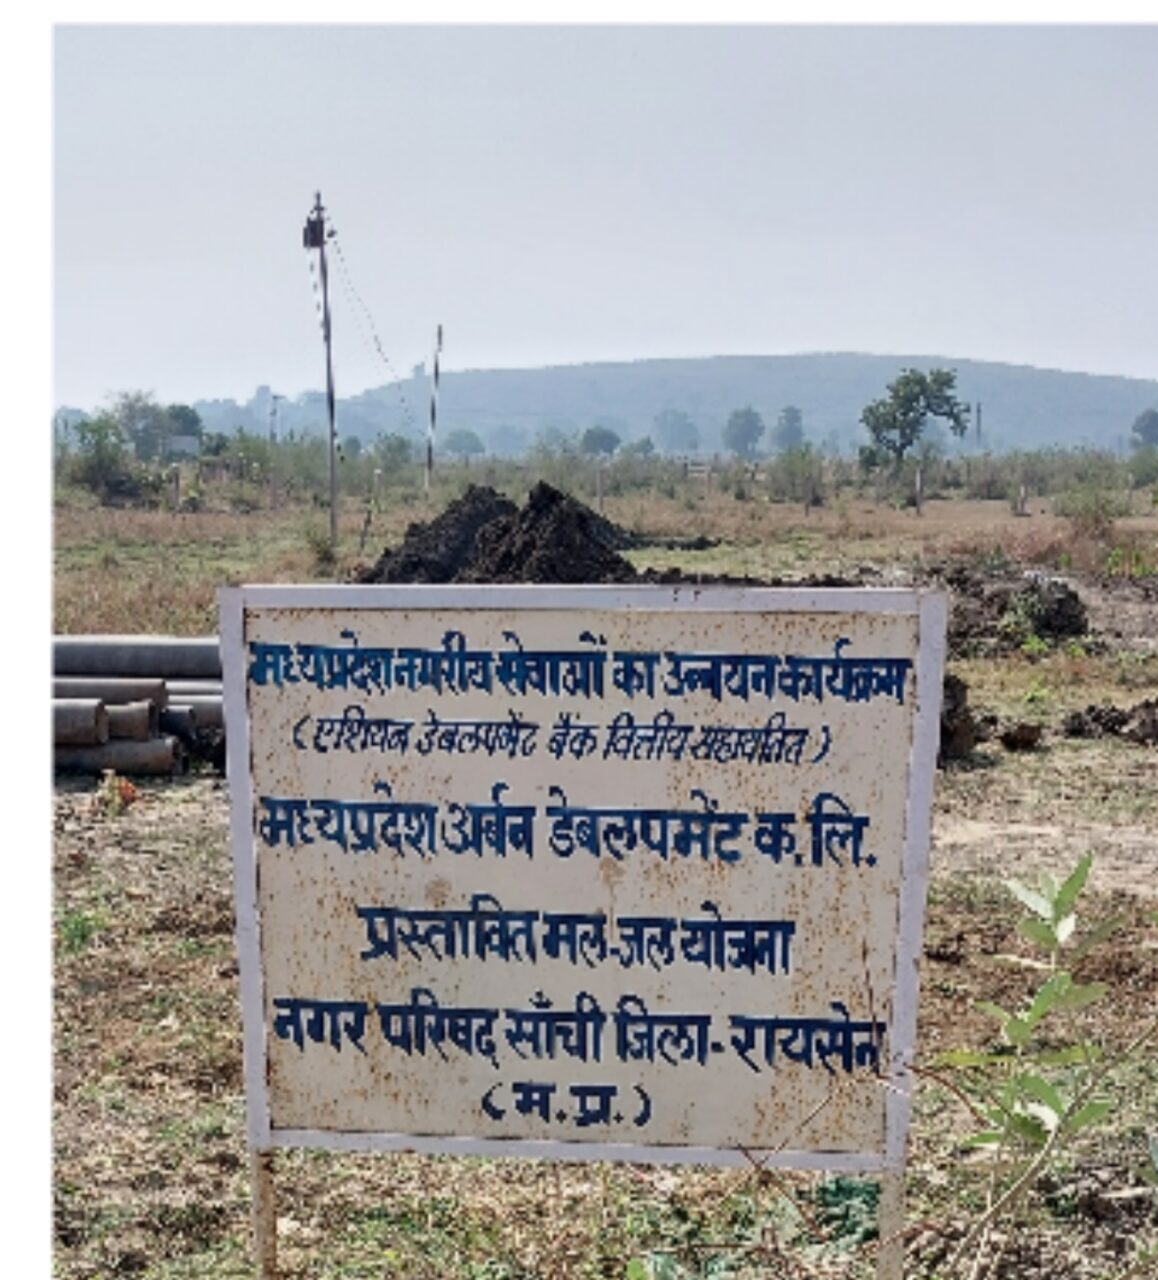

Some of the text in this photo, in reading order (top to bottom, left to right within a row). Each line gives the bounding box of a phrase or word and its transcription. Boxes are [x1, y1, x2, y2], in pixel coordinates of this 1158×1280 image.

[249, 629, 394, 696] मध्यप्रदेश
[613, 650, 661, 699] का
[780, 637, 913, 705] कार्यक्रम
[547, 711, 600, 760] बैंक
[260, 781, 438, 858] मध्यप्रदेश
[441, 782, 536, 860] अर्बन
[354, 893, 539, 965] प्रस्तावित
[681, 901, 796, 975] योजना
[273, 998, 370, 1057] नगर
